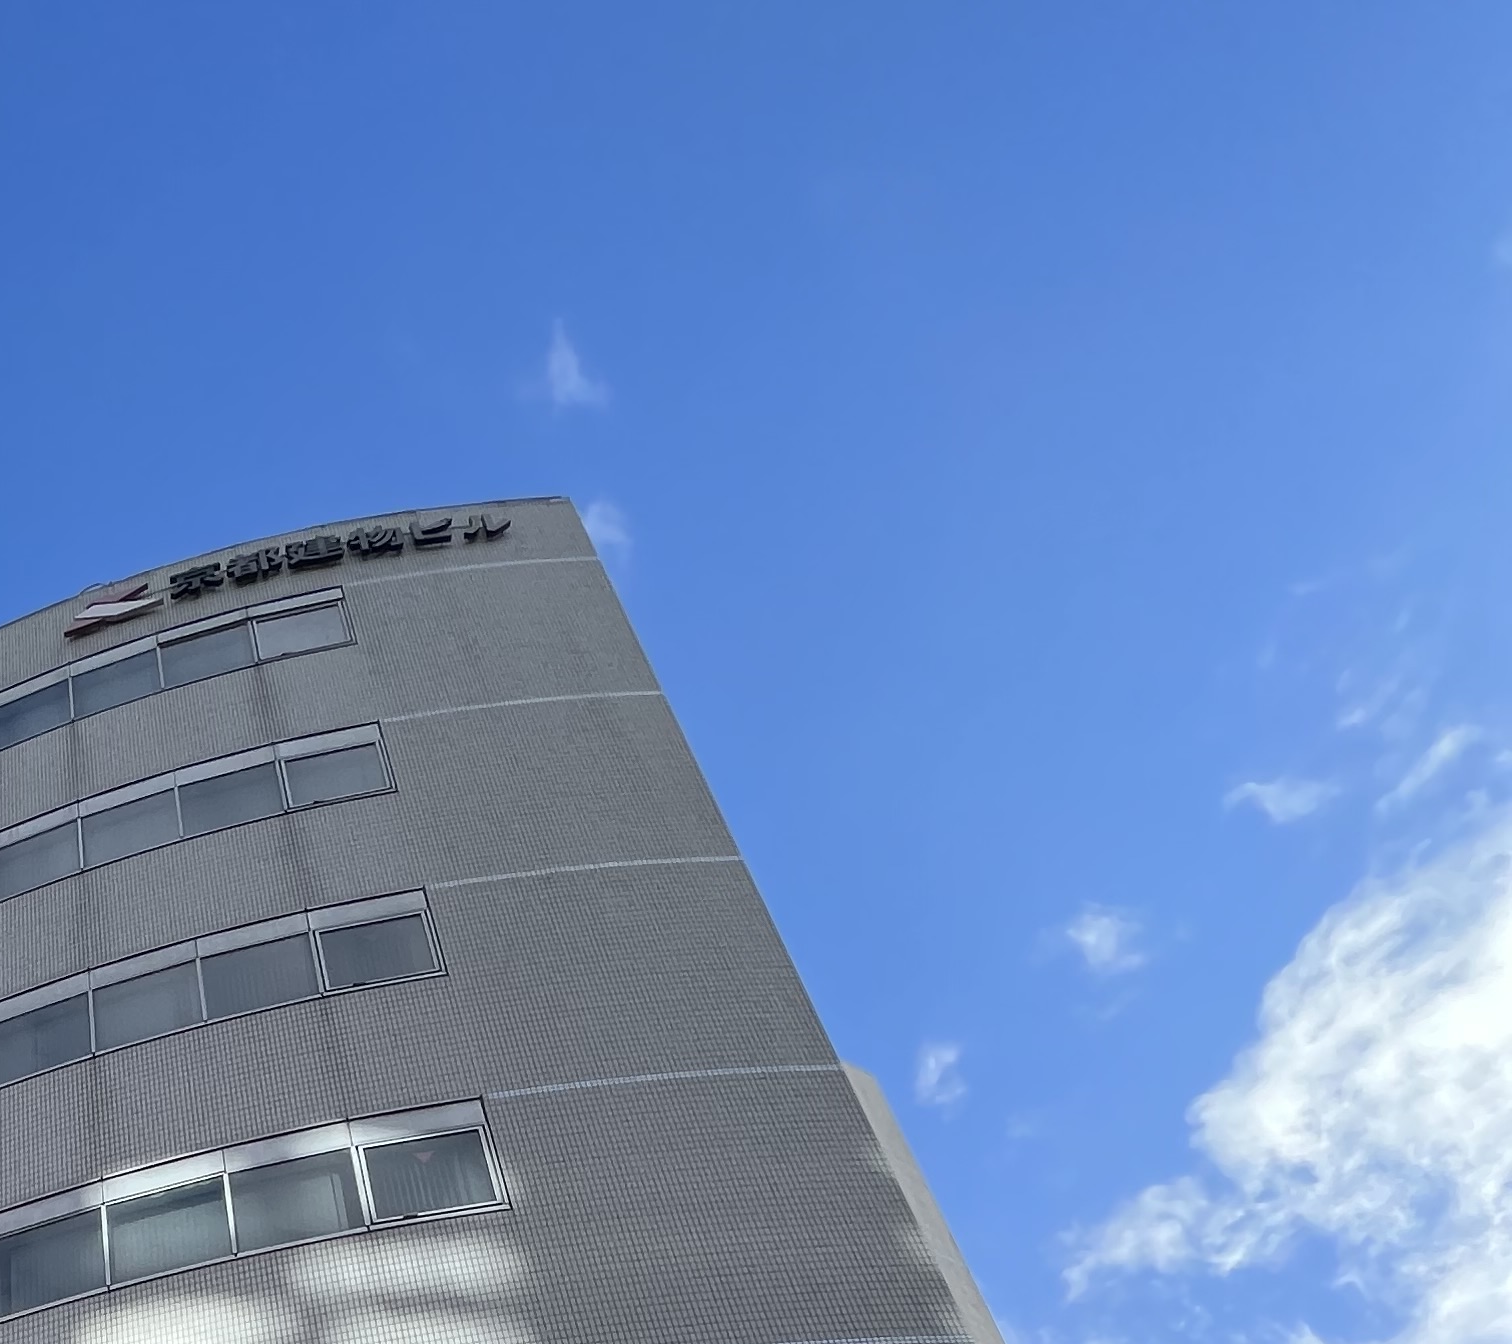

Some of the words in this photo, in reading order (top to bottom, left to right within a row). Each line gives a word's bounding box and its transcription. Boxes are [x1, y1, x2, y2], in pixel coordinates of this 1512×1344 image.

[170, 512, 511, 600] 京都建物ビル
